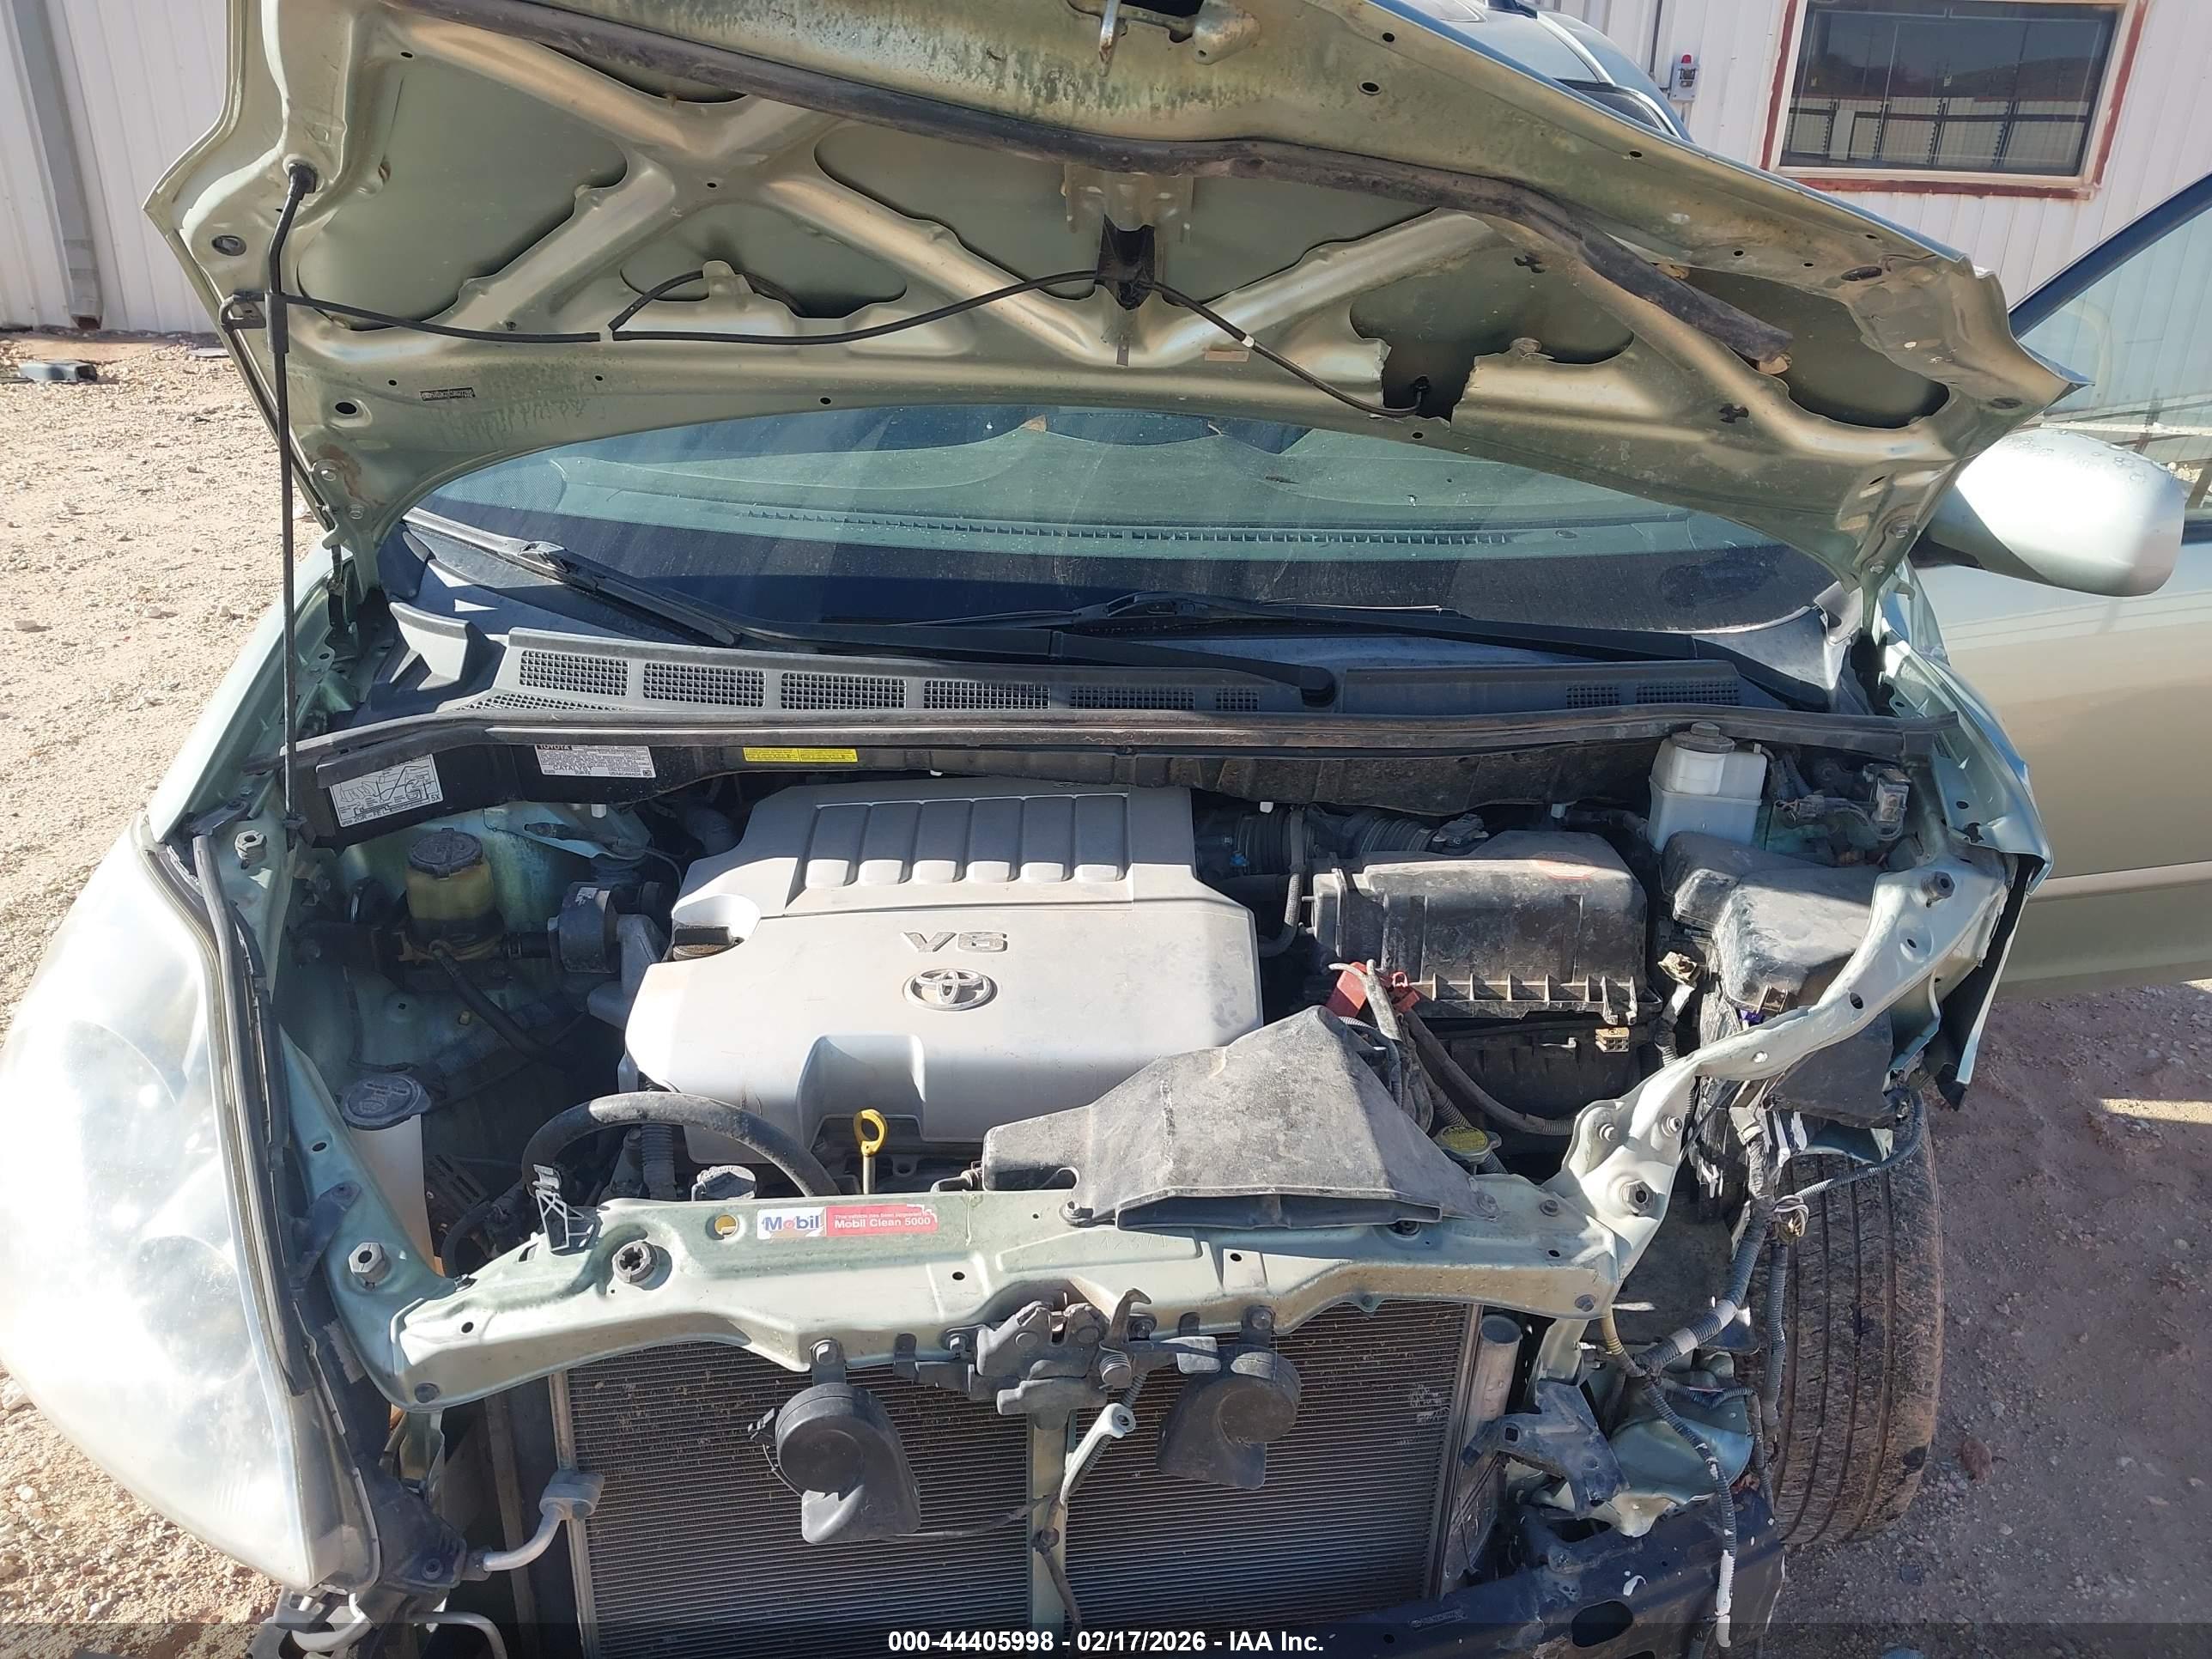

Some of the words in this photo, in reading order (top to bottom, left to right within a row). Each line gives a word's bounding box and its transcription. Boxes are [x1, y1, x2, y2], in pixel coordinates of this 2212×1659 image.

[902, 931, 1008, 952] V6
[763, 1215, 819, 1231] Mobil
[834, 1218, 866, 1229] Mobil
[869, 1218, 902, 1227] Clean
[904, 1217, 932, 1226] 5000
